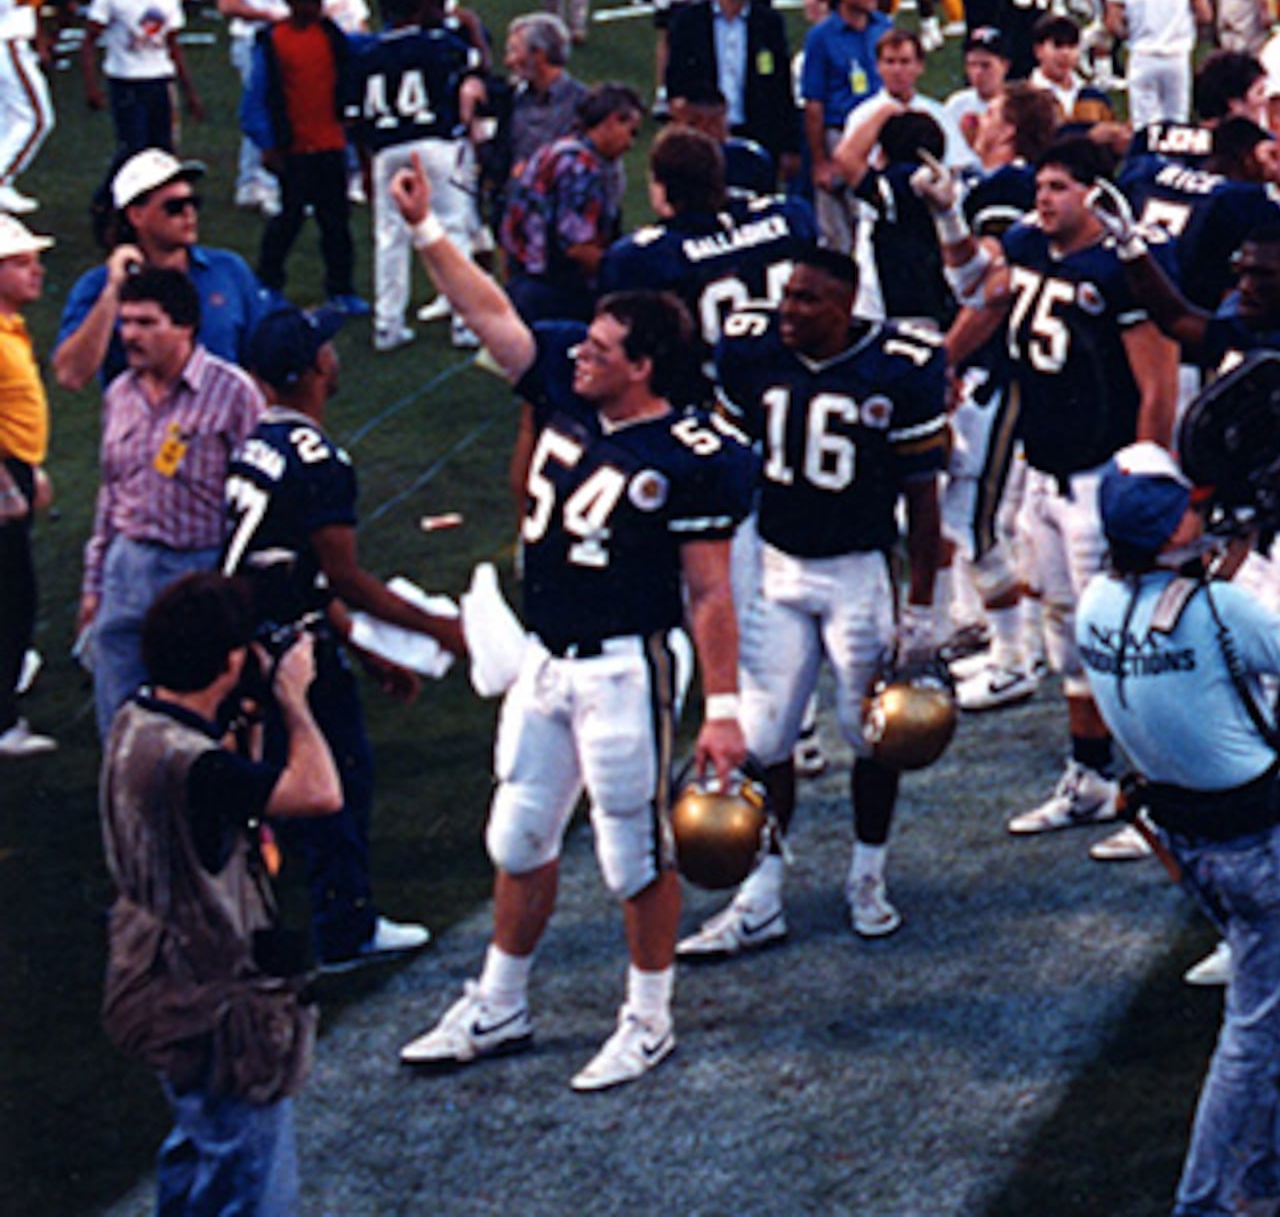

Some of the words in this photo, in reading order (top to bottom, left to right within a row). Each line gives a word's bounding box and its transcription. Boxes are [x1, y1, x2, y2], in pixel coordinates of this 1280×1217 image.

[1004, 265, 1076, 374] 75
[762, 385, 859, 491] 16
[520, 425, 627, 568] 54
